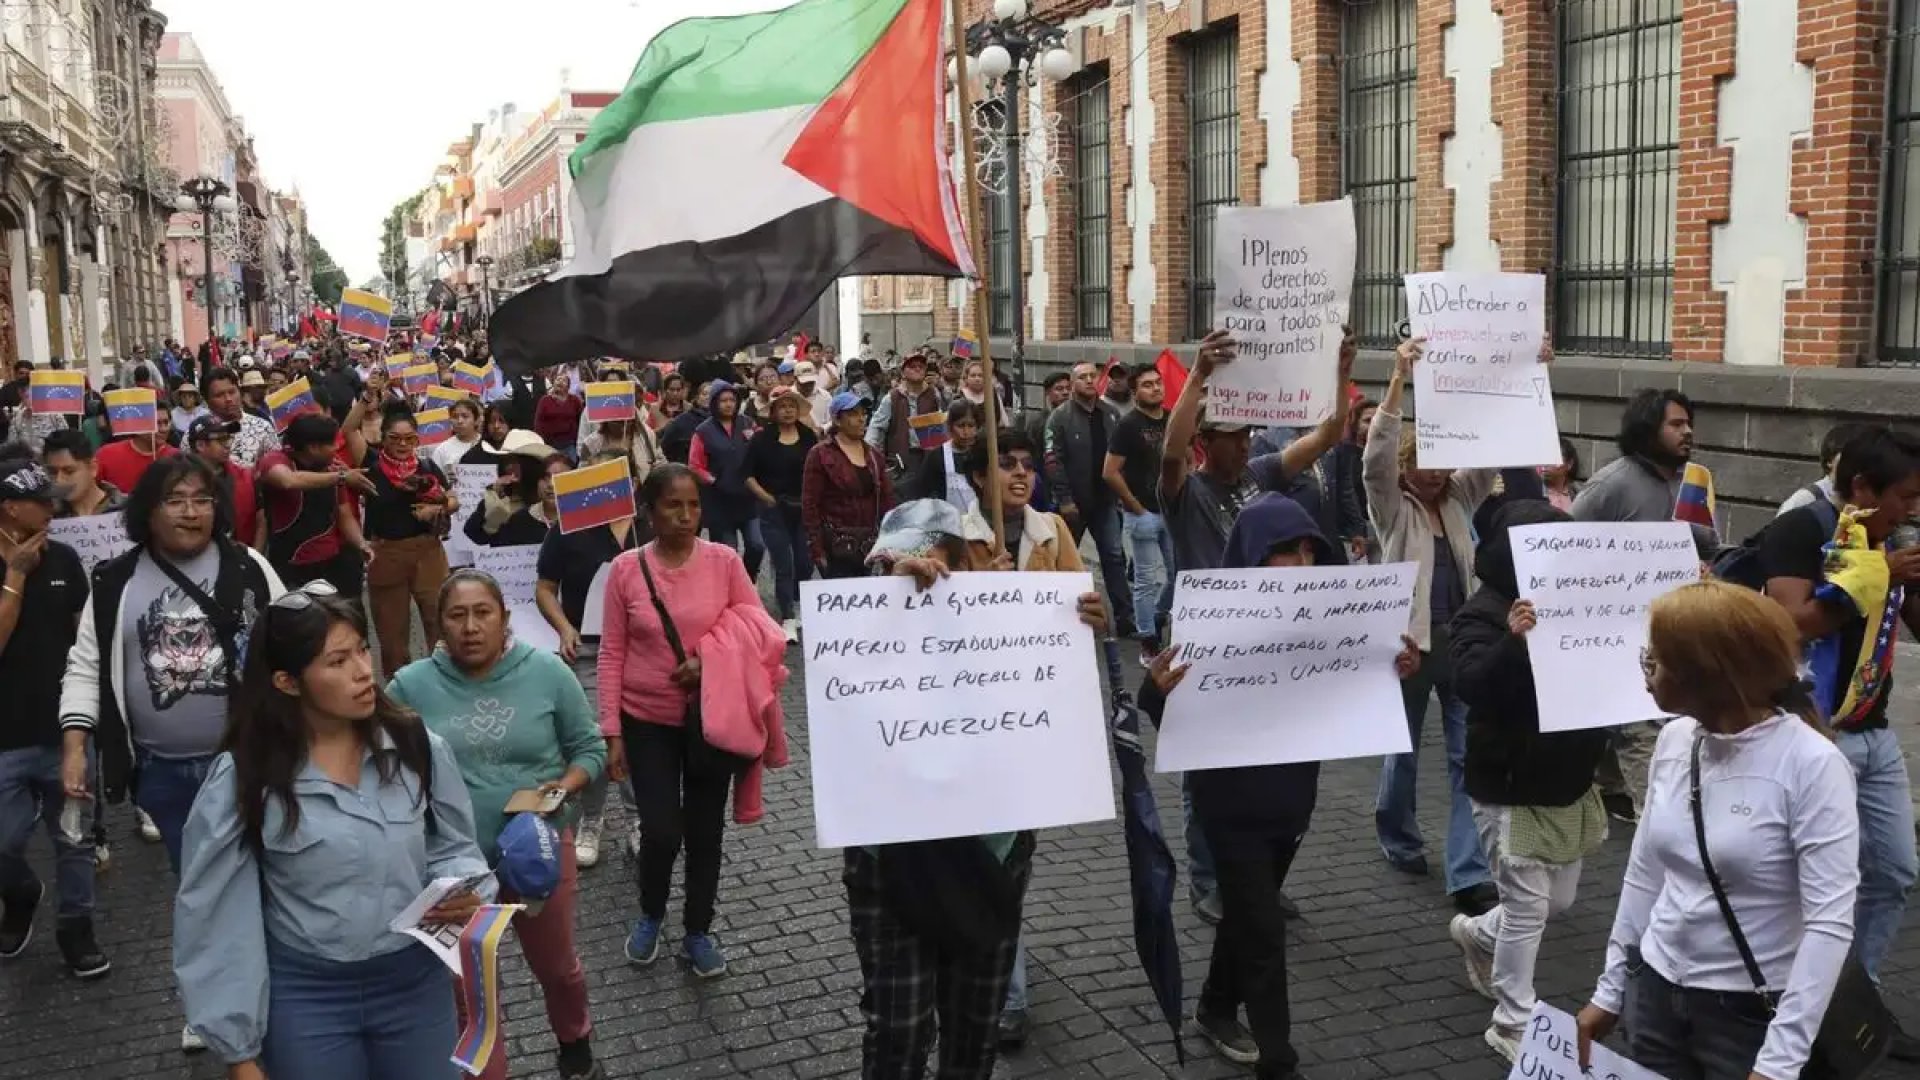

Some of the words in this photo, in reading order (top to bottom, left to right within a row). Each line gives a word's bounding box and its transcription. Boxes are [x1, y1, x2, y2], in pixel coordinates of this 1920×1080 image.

[1262, 268, 1327, 289] derechos
[1232, 288, 1252, 309] de
[1225, 316, 1266, 332] para
[1279, 310, 1321, 332] todos
[1325, 305, 1340, 324] los
[1510, 330, 1528, 342] en
[1427, 349, 1478, 364] contra
[1489, 348, 1512, 368] del
[1213, 386, 1240, 403] Liga
[1247, 391, 1269, 404] por
[1278, 387, 1293, 402] la
[1299, 387, 1312, 401] IV
[1214, 402, 1308, 420] Internacional
[1607, 538, 1617, 550] A
[1623, 539, 1643, 551] LOS
[1258, 580, 1285, 593] DEL
[1293, 577, 1348, 595] MUNDO
[1529, 575, 1547, 590] DE
[1634, 570, 1649, 585] DE
[816, 591, 889, 613] PARAR
[903, 594, 934, 611] LA
[947, 588, 1024, 616] GUERRA
[1034, 590, 1065, 606] DEL
[1584, 605, 1593, 619] Y
[1598, 604, 1613, 617] DE
[1620, 604, 1637, 616] LA
[1177, 606, 1284, 622] DERROTEMOS
[1292, 608, 1313, 623] AL
[813, 641, 907, 660] IMPERIO
[1180, 641, 1218, 662] HOY
[1222, 640, 1328, 659] ENCABEZADO
[1336, 633, 1369, 650] POR
[1559, 634, 1625, 650] ENTERA
[825, 675, 906, 701] CONTRA
[917, 675, 944, 691] EL
[953, 669, 1021, 688] PUEBLO
[1034, 665, 1056, 683] DE
[1197, 671, 1279, 692] ESTADOS
[878, 708, 1050, 747] VENEZUELA
